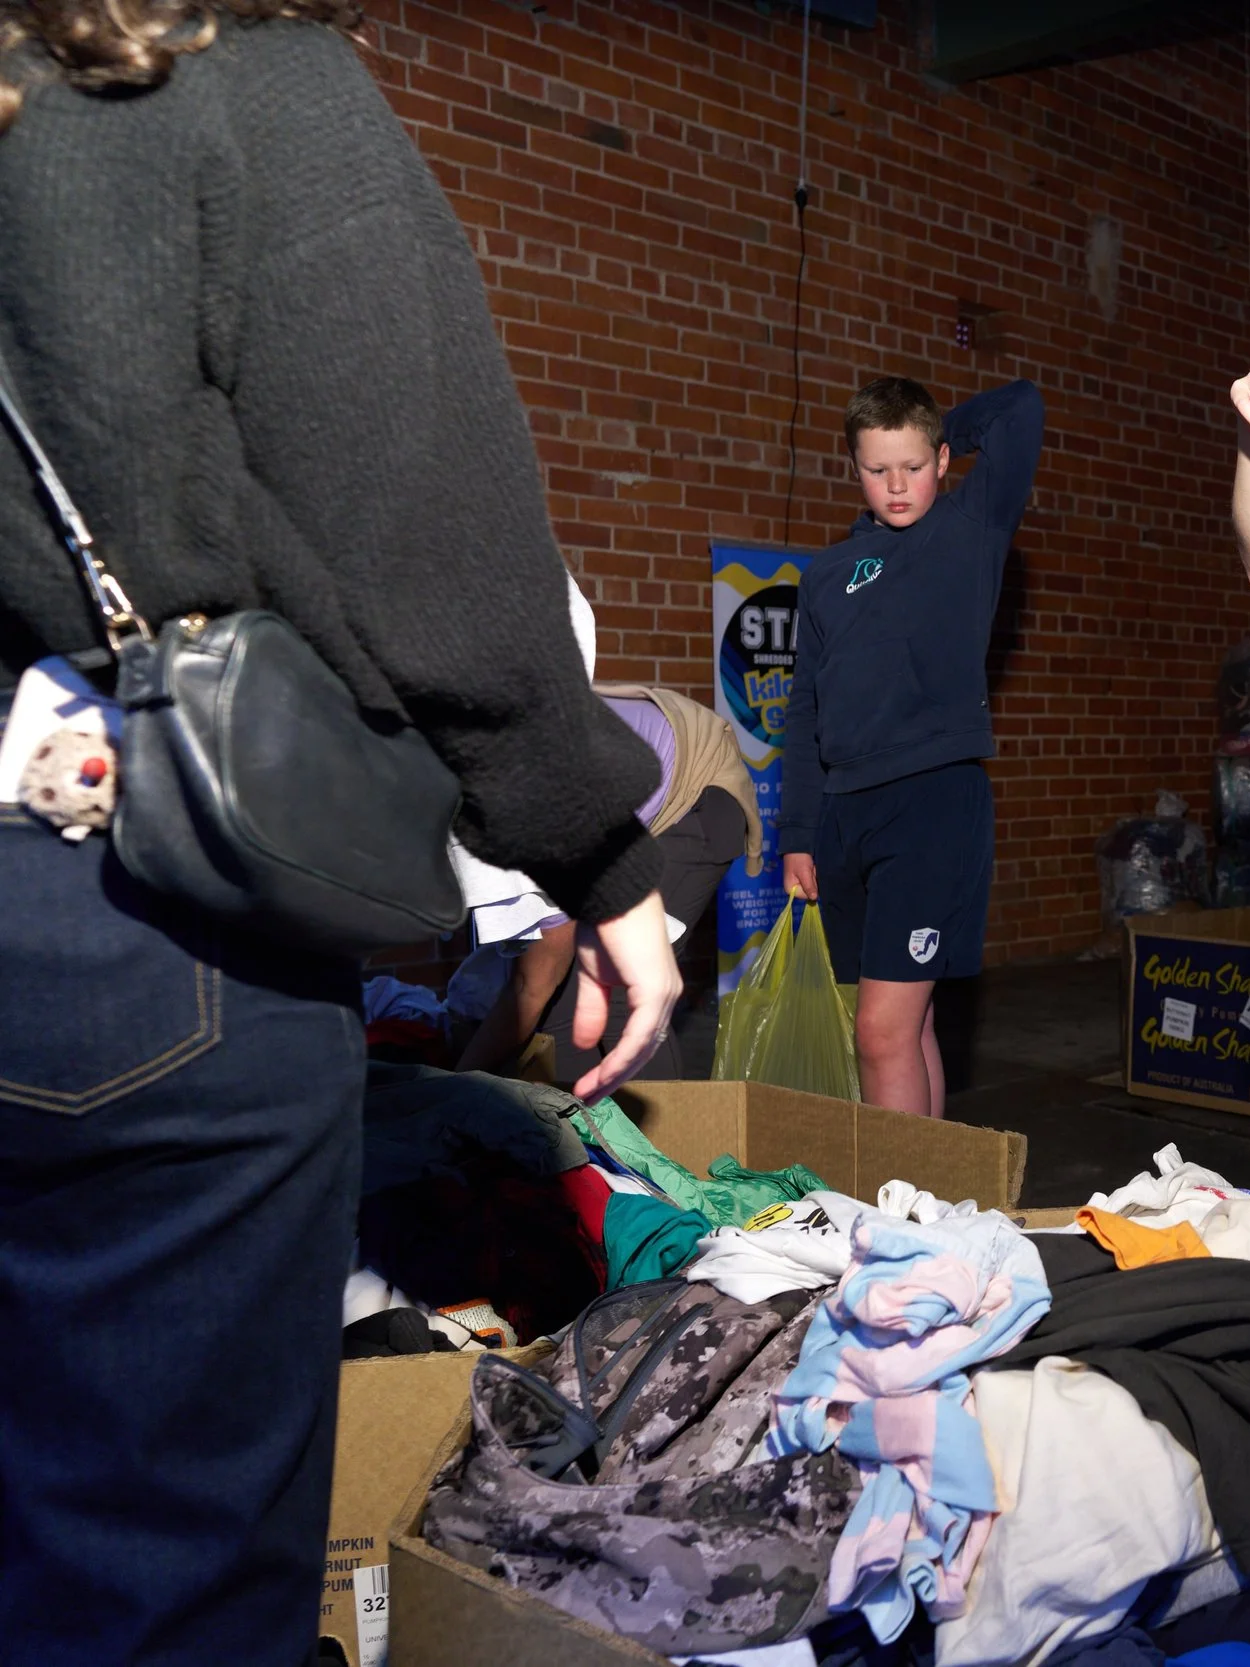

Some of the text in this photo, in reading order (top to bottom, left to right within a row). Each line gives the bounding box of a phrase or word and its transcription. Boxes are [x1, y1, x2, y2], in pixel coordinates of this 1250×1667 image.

[753, 652, 794, 666] SHREDDED
[724, 887, 784, 901] FEEL FRE
[732, 897, 787, 909] WEIGHIN
[743, 907, 767, 918] FOR
[1143, 953, 1212, 991] Golden
[328, 1536, 374, 1553] MPKIN
[322, 1578, 353, 1593] PUM
[363, 1595, 389, 1613] 32
[365, 1634, 389, 1644] UNIVE
